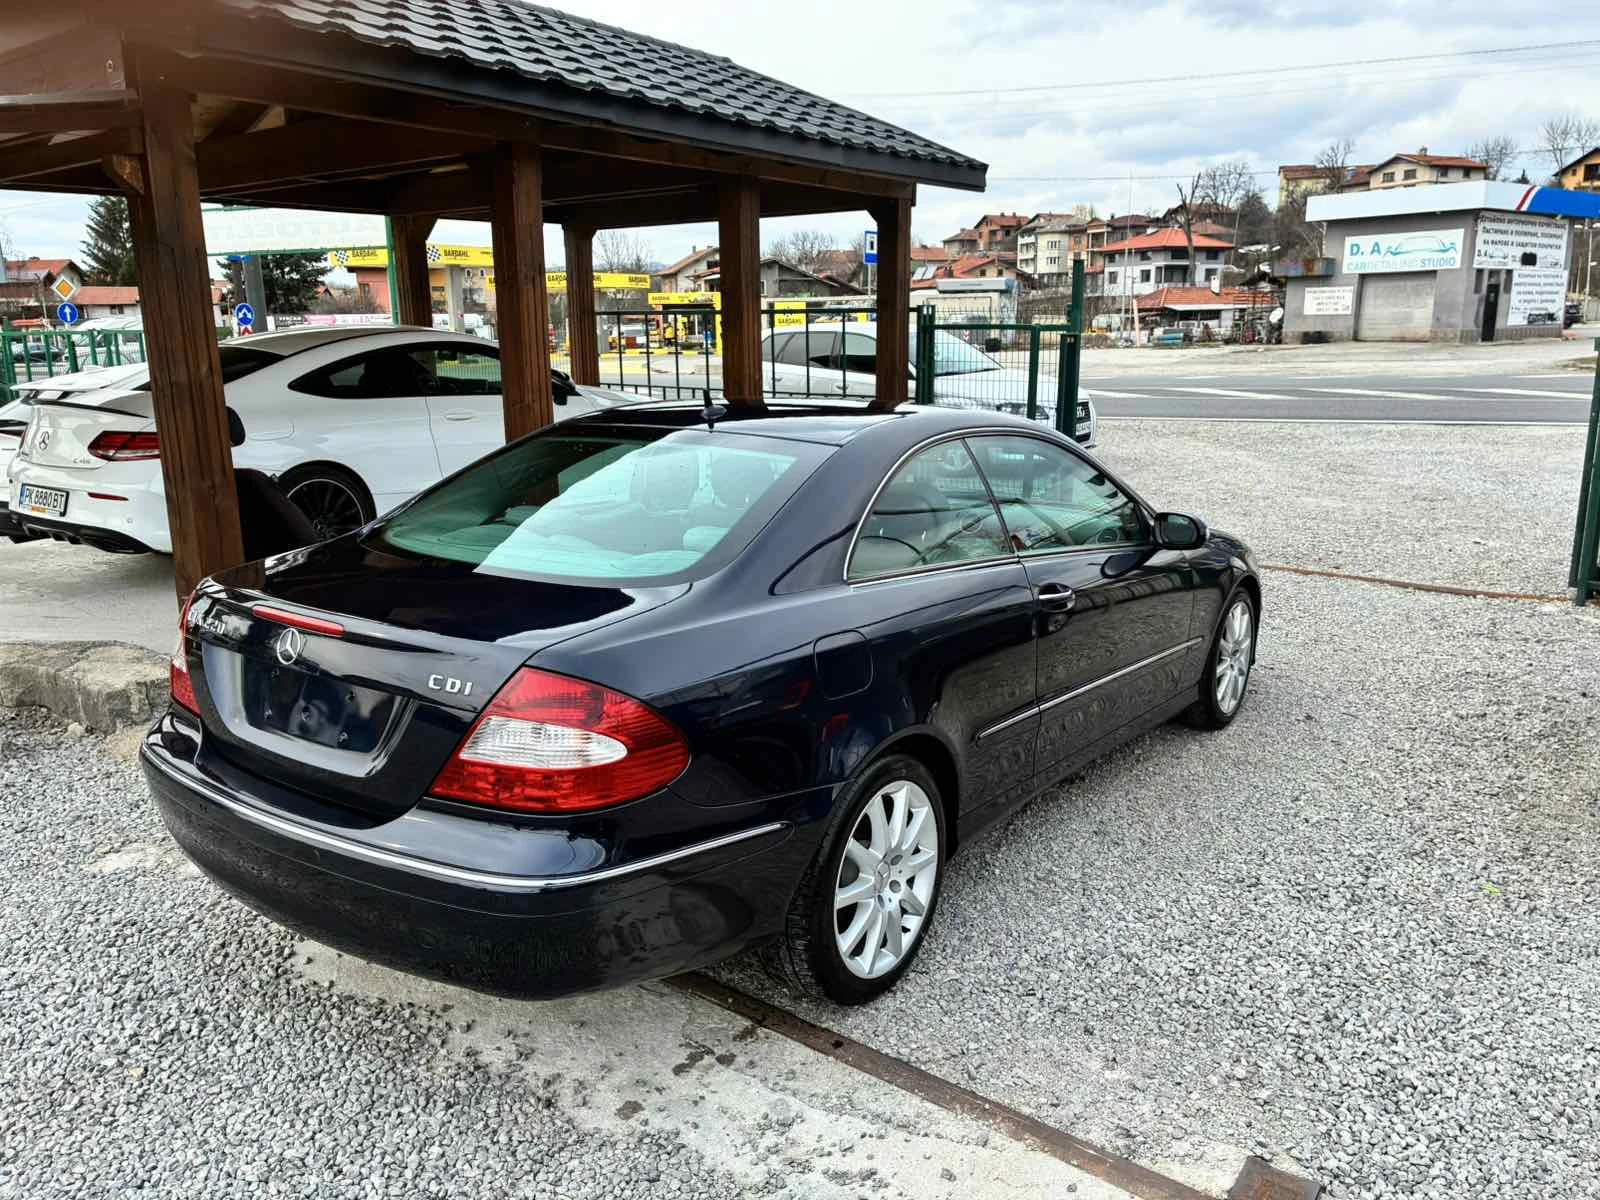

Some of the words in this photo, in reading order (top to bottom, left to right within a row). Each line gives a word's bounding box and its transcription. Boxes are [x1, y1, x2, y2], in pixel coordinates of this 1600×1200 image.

[443, 249, 470, 258] BARDAHL
[1370, 241, 1381, 255] A
[1420, 257, 1457, 268] STUDIO
[428, 674, 473, 697] CDI
